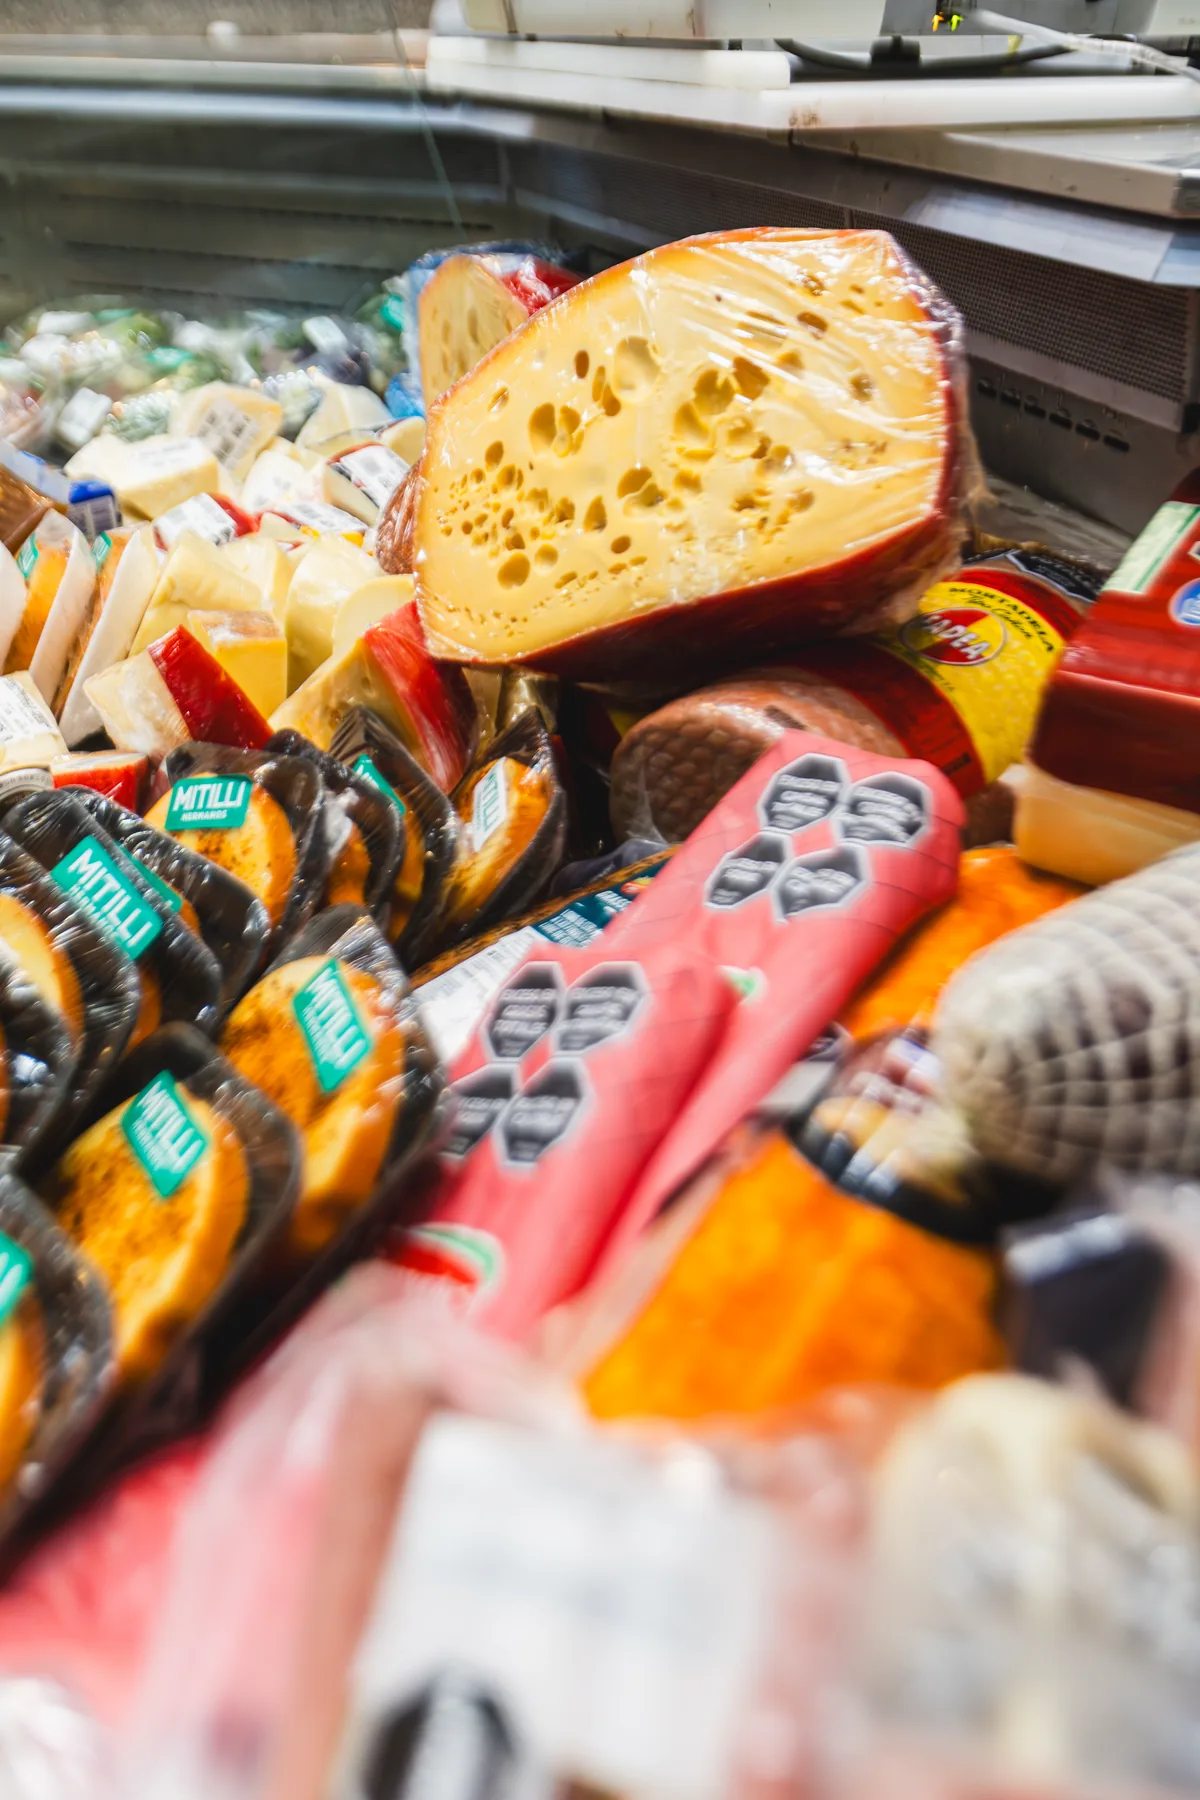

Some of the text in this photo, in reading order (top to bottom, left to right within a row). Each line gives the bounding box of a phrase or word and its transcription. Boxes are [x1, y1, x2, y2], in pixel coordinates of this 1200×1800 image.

[948, 586, 1055, 653] MORTADELA
[172, 781, 247, 811] MITILLI
[180, 809, 228, 822] HERMANOS
[67, 848, 153, 948] MITILLI
[304, 967, 367, 1070] MITILLI
[136, 1080, 205, 1174] MITILLI
